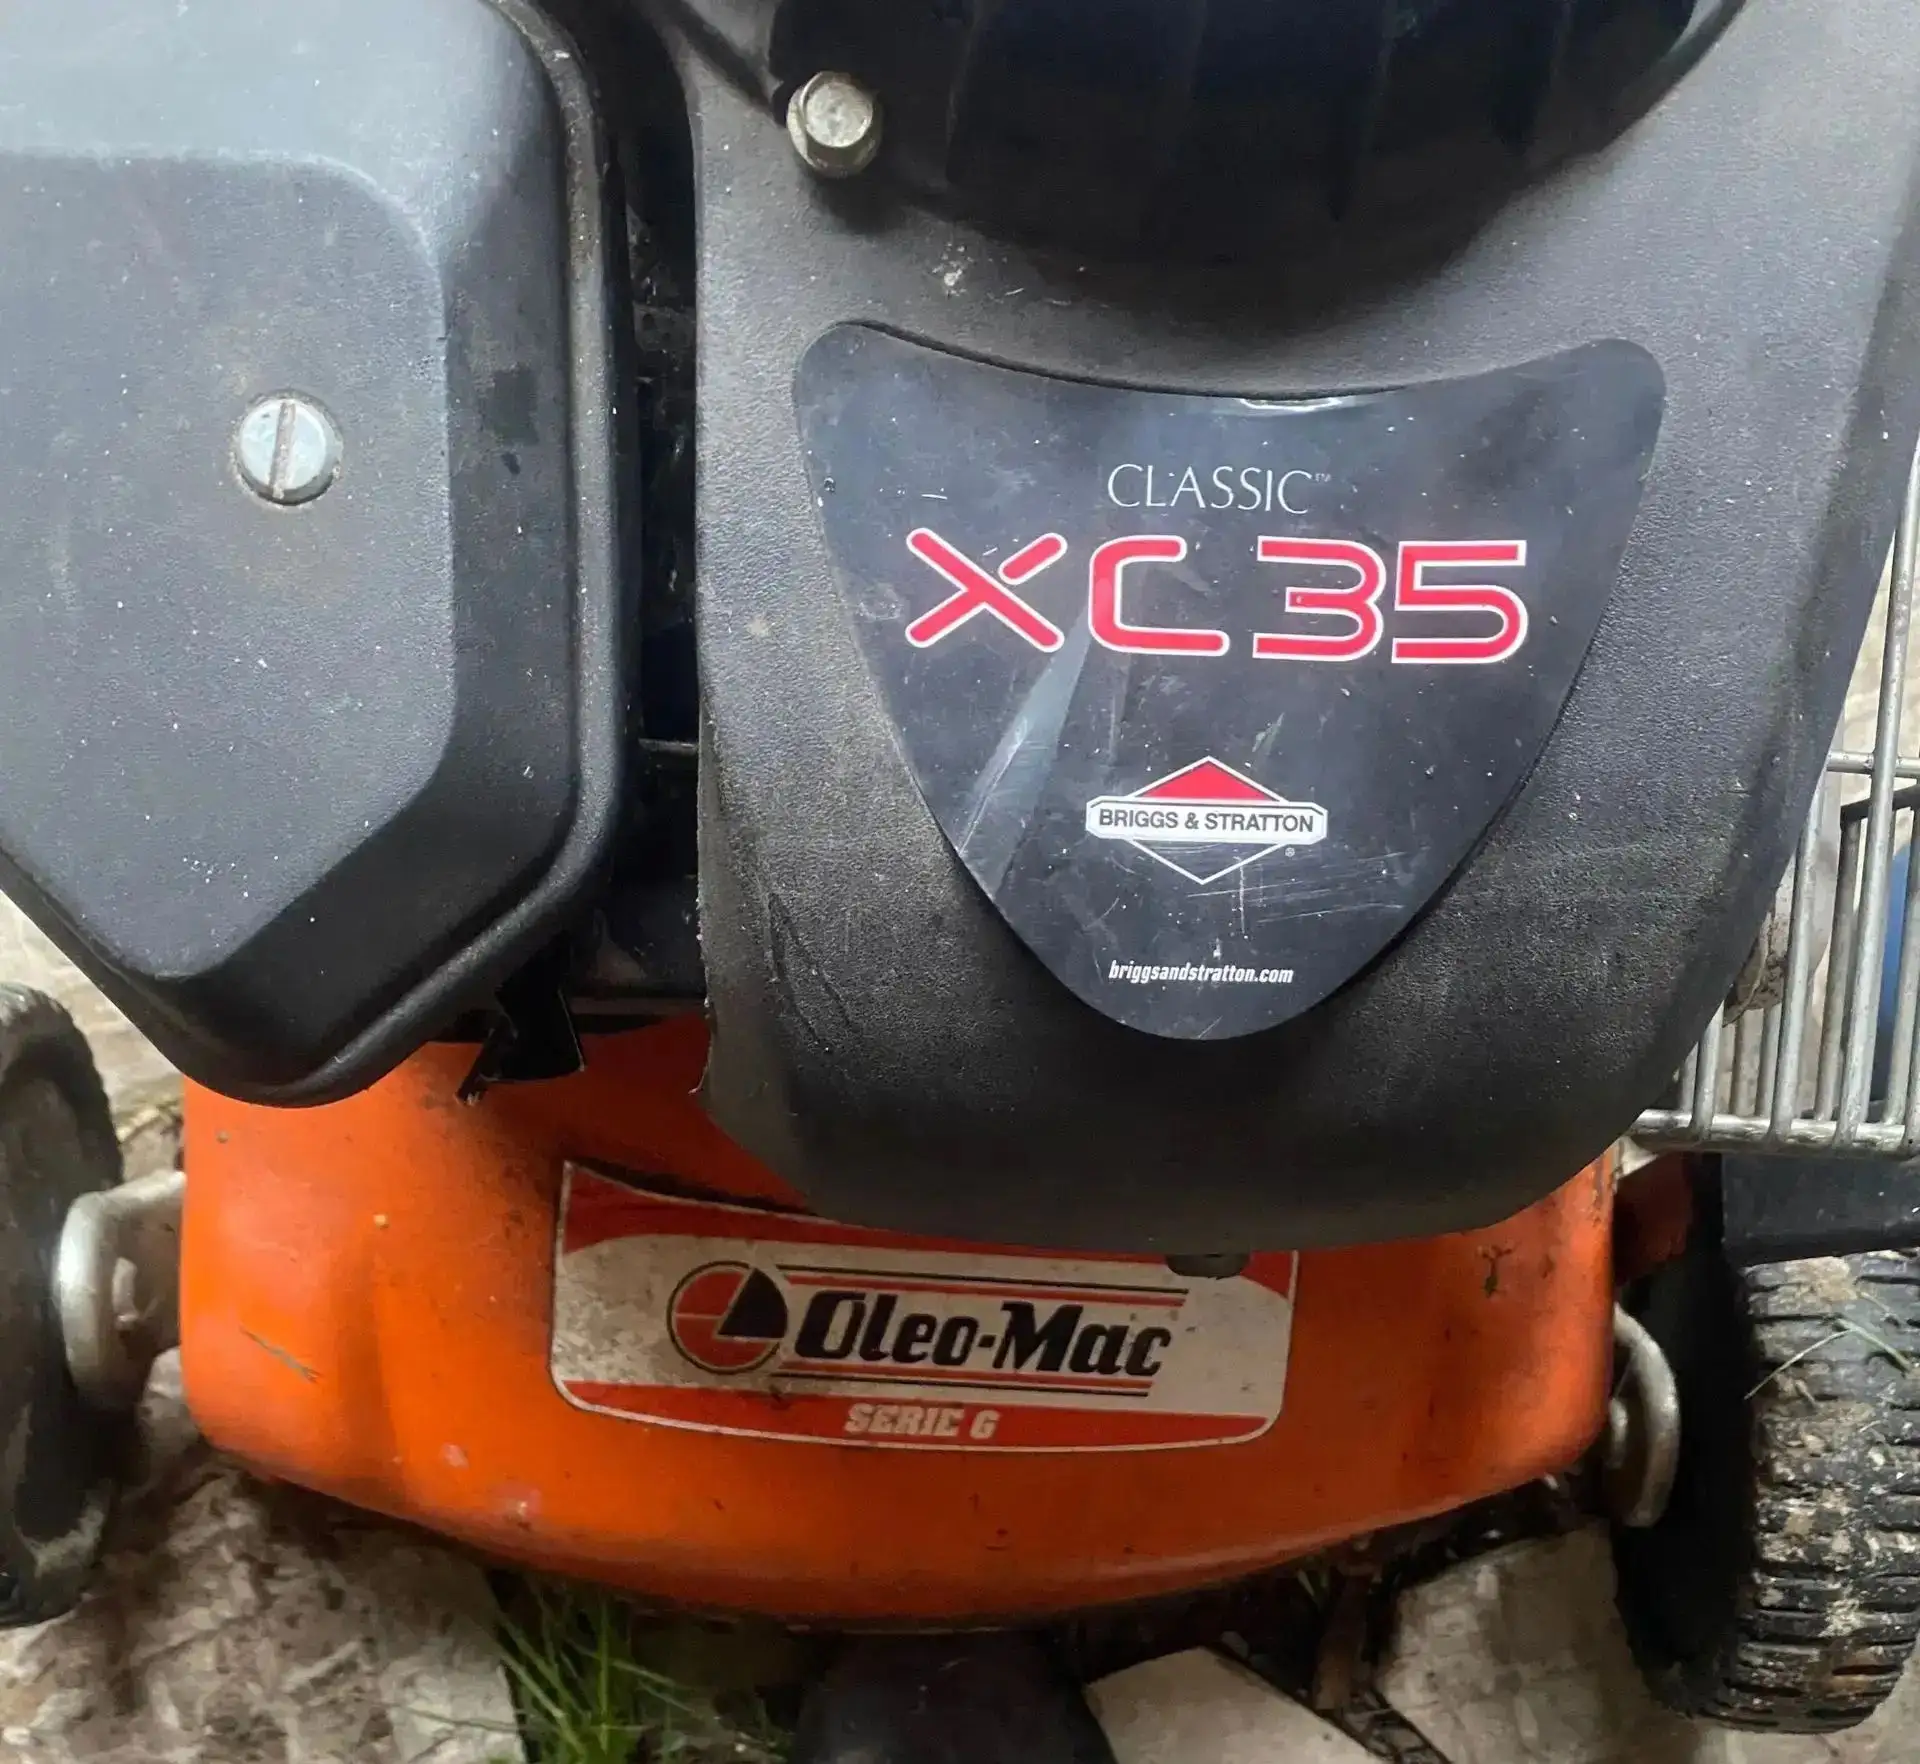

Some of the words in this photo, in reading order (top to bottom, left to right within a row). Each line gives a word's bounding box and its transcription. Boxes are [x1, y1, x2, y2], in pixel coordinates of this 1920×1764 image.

[1099, 808, 1179, 829] BRIGGS
[1184, 812, 1199, 830] &
[1204, 811, 1314, 833] STRATTON
[1108, 959, 1294, 984] briggsandstratton.com
[794, 1289, 1171, 1378] Oleo-Mac
[844, 1403, 964, 1436] SERIE
[969, 1410, 1001, 1439] G
